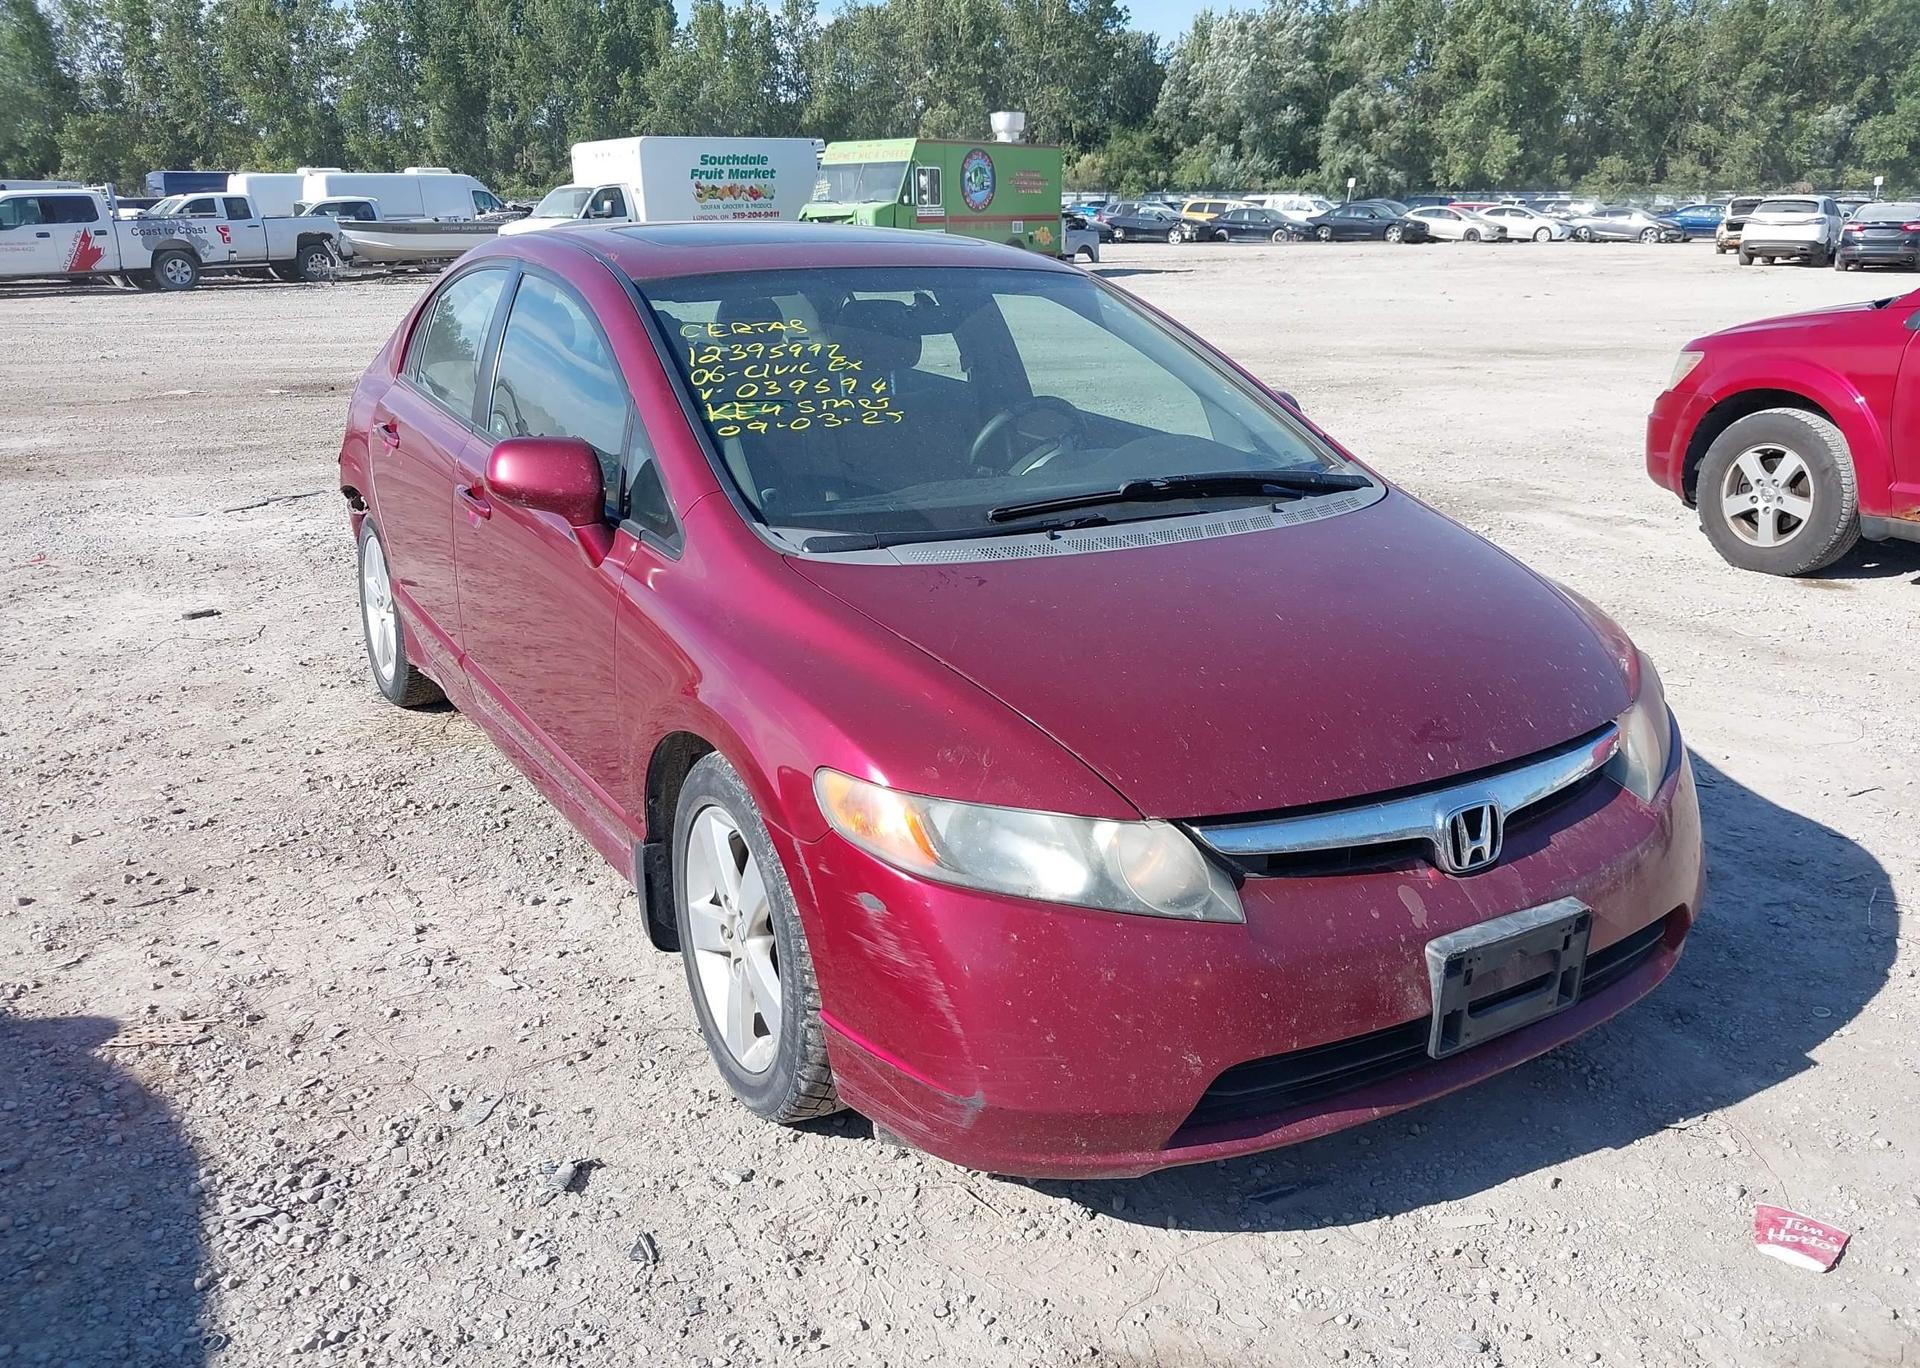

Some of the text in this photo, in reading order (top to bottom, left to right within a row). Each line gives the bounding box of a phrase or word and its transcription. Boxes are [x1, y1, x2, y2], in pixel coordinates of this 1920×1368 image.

[700, 154, 769, 166] Southdale
[690, 168, 777, 180] Fruit Market
[732, 211, 780, 220] 519-204-9411
[130, 225, 207, 237] Coast to Coast
[1777, 1216, 1825, 1236] Tim
